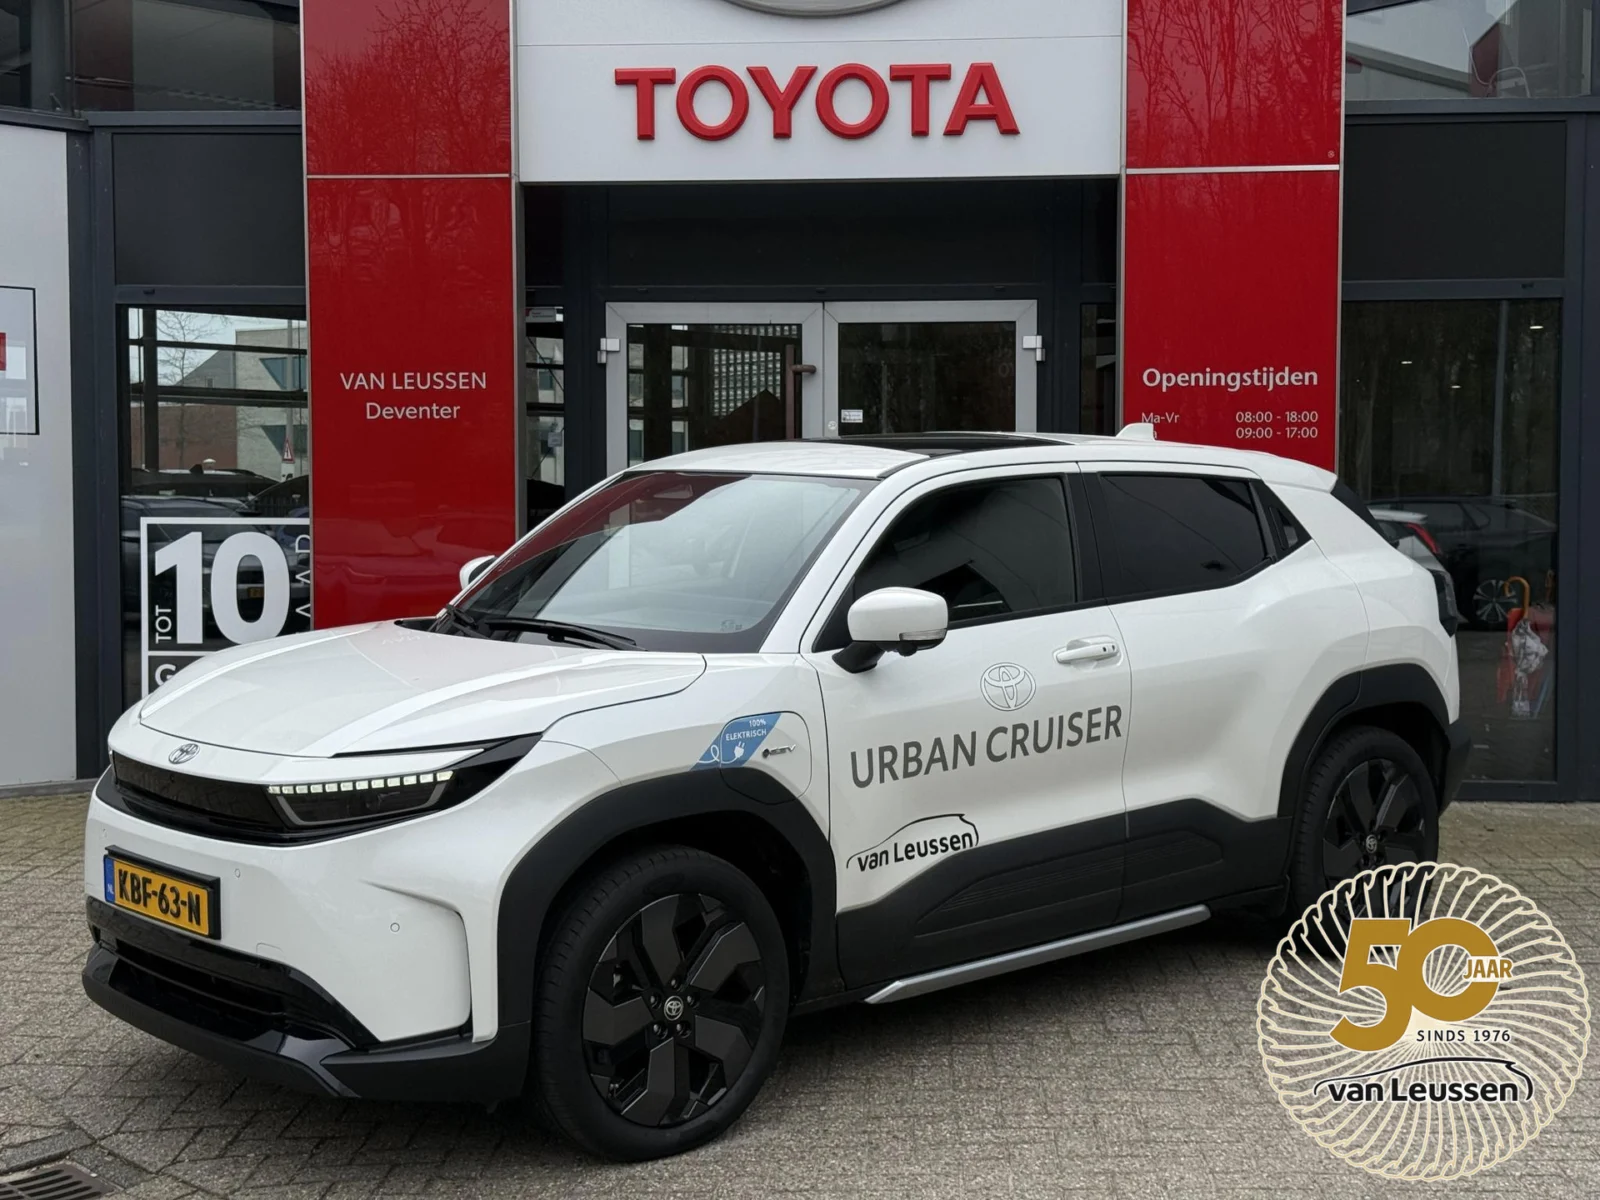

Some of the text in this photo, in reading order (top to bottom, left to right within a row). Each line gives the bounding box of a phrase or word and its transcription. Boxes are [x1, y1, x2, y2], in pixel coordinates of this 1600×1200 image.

[614, 63, 1021, 141] TOYOTA
[340, 372, 486, 390] VAN LEUSSEN
[1142, 366, 1318, 392] Openingstijden
[366, 402, 460, 419] Deventer
[1141, 411, 1180, 424] Ma-Vr
[1235, 411, 1273, 423] 08:00
[1285, 411, 1318, 423] 18:00
[1235, 427, 1273, 439] 09:00
[1285, 427, 1318, 438] 17:00
[155, 531, 290, 645] 10
[155, 605, 172, 644] TOT
[725, 729, 767, 741] ELEKTRISCH
[749, 719, 766, 728] 100%
[850, 705, 1122, 788] URBAN CRUISER
[857, 832, 974, 872] van Leussen
[118, 868, 201, 926] KBF-63-N
